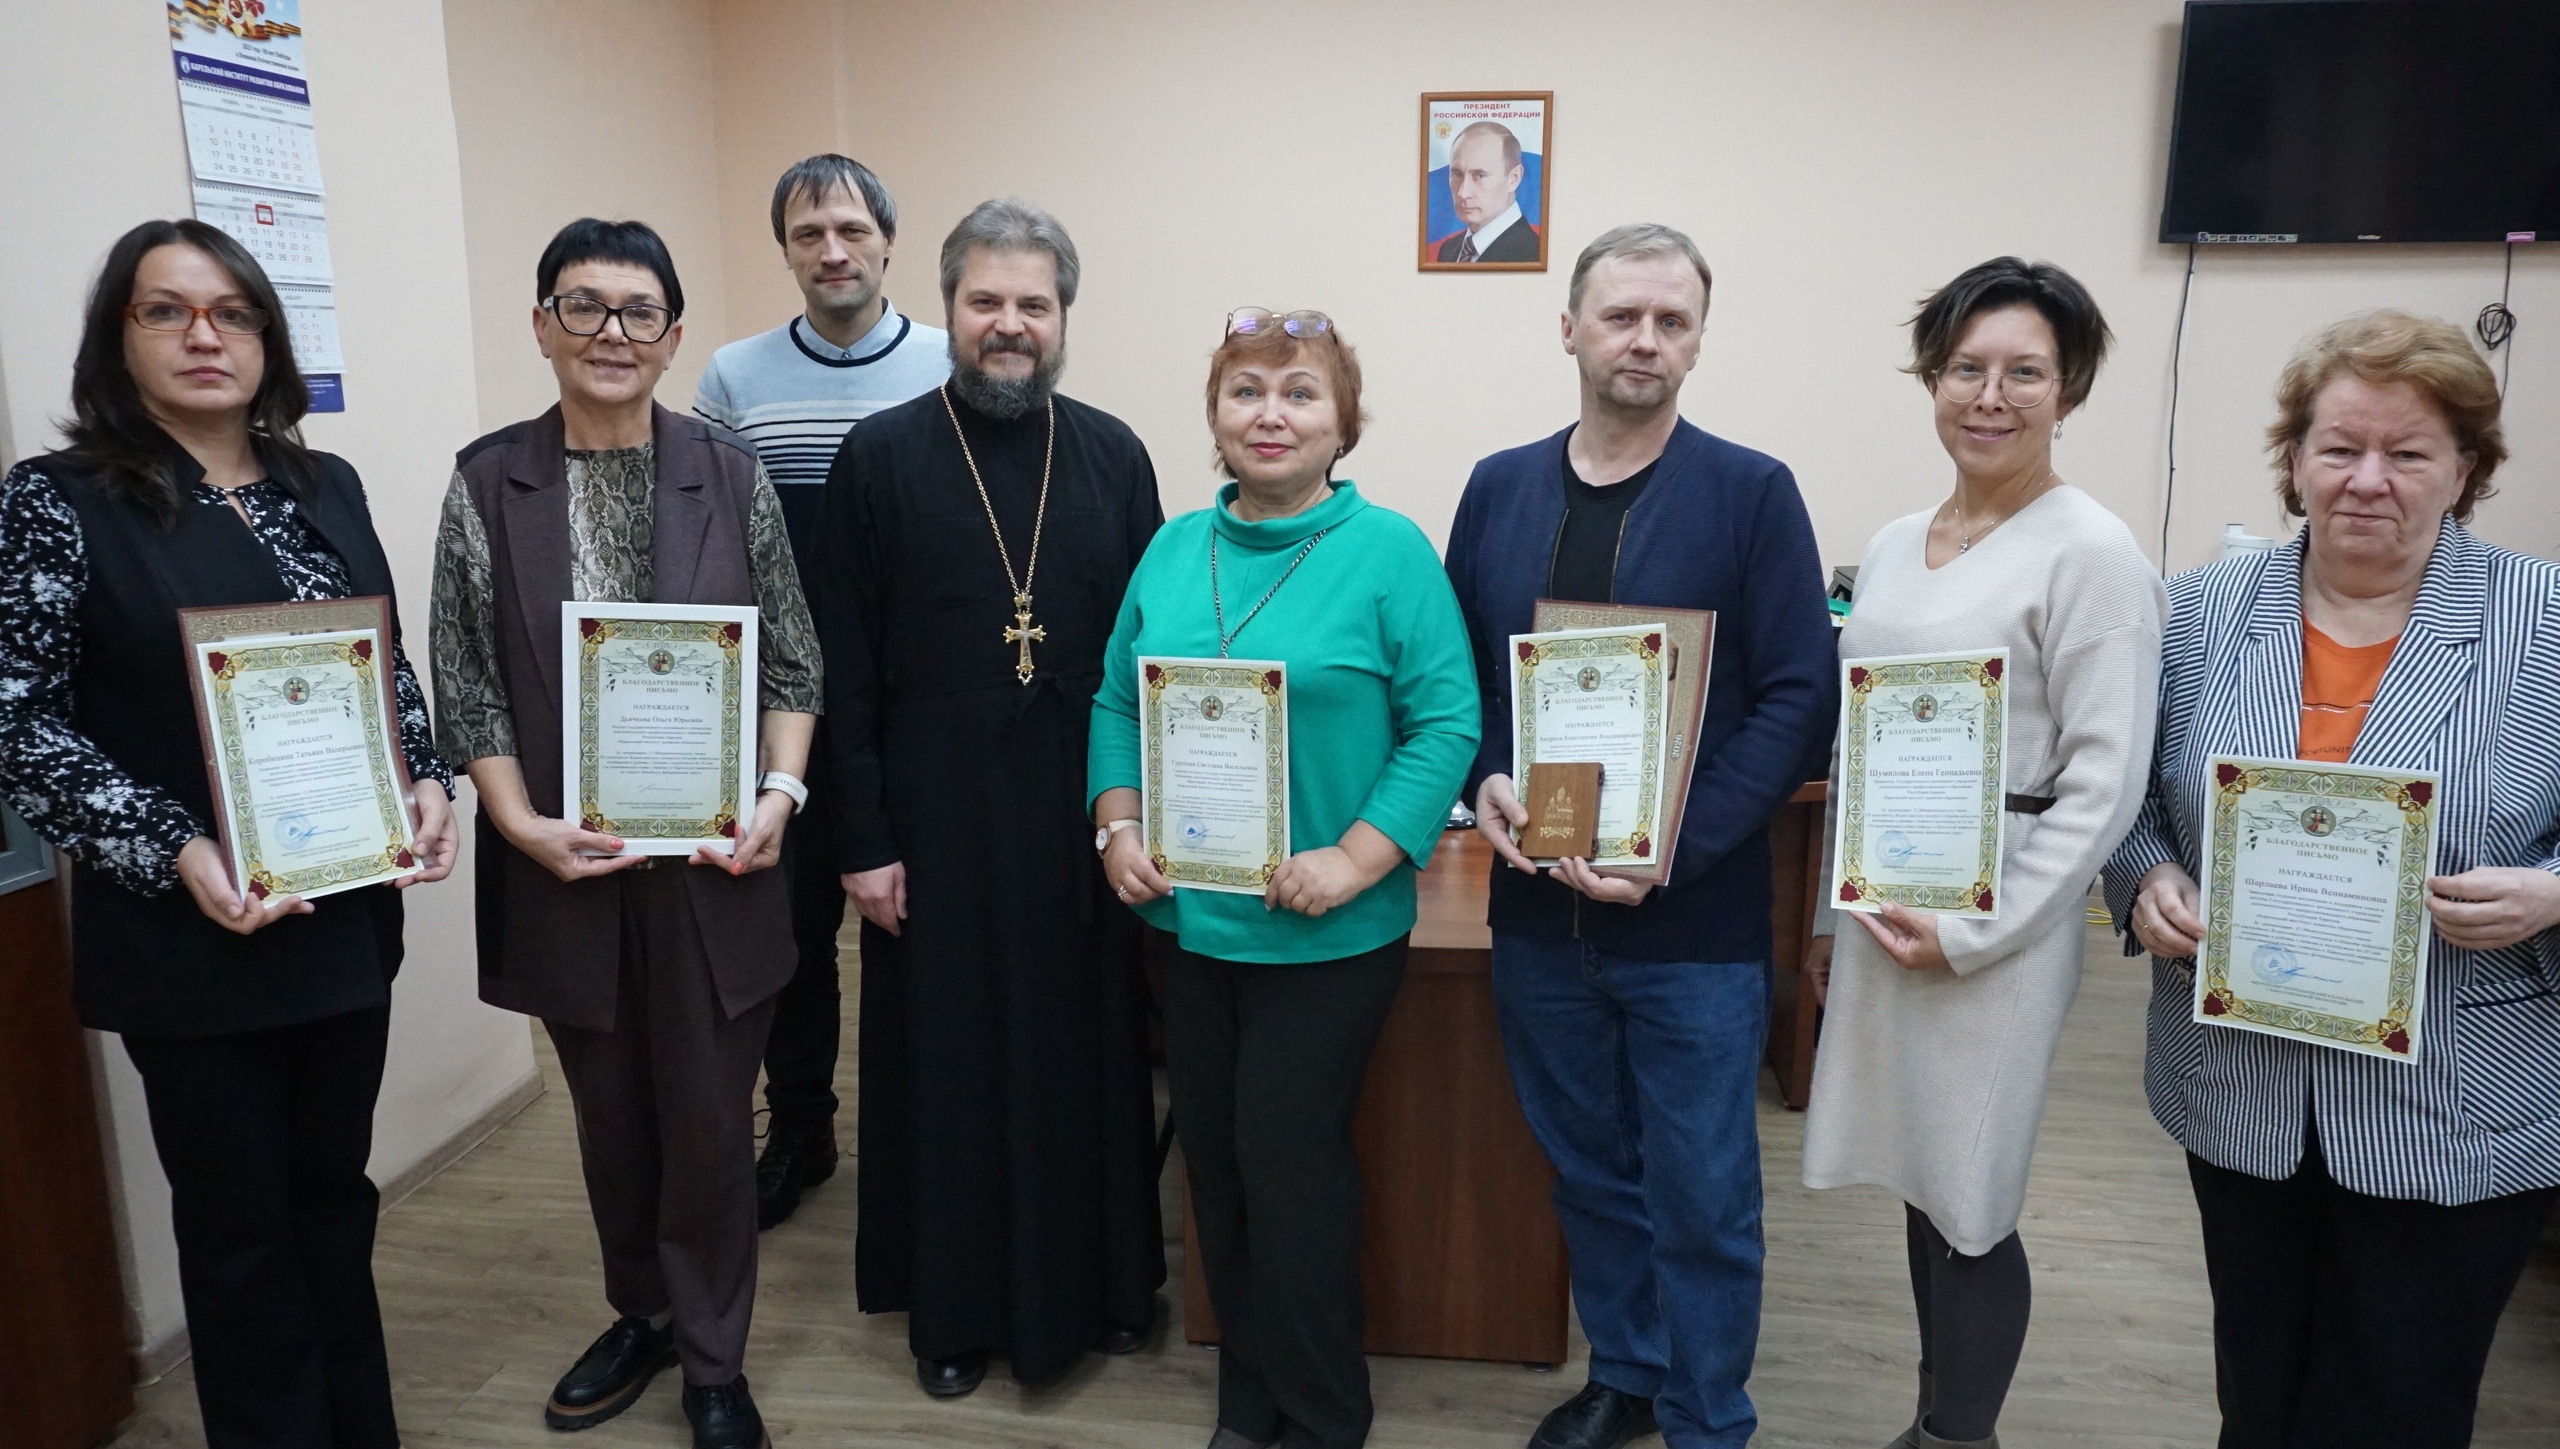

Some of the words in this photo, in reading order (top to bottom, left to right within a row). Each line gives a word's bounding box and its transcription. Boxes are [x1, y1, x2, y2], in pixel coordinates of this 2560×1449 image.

[1555, 696, 1624, 704] БЛАГОДАРСТВЕННОЕ
[261, 706, 338, 720] БЛАГОДАРСТВЕННОЕ
[287, 717, 319, 726] ПИСЬМО
[1180, 724, 1246, 733] БЛАГОДАРСТВЕННОЕ
[277, 734, 333, 747] НАГРАЖДАЕТСЯ
[295, 749, 324, 758] Татьяна
[326, 744, 365, 755] Валерьевна
[1189, 749, 1237, 757] НАГРАЖДАЕТСЯ
[1870, 769, 1910, 779] Шумилова
[2266, 837, 2369, 855] БЛАГОДАРСТВЕННОЕ
[2297, 850, 2339, 860] ПИСЬМО
[2278, 868, 2352, 883] НАГРАЖДАЕТСЯ
[2290, 884, 2318, 894] Ирина
[2321, 888, 2387, 904] Вениаминовна
